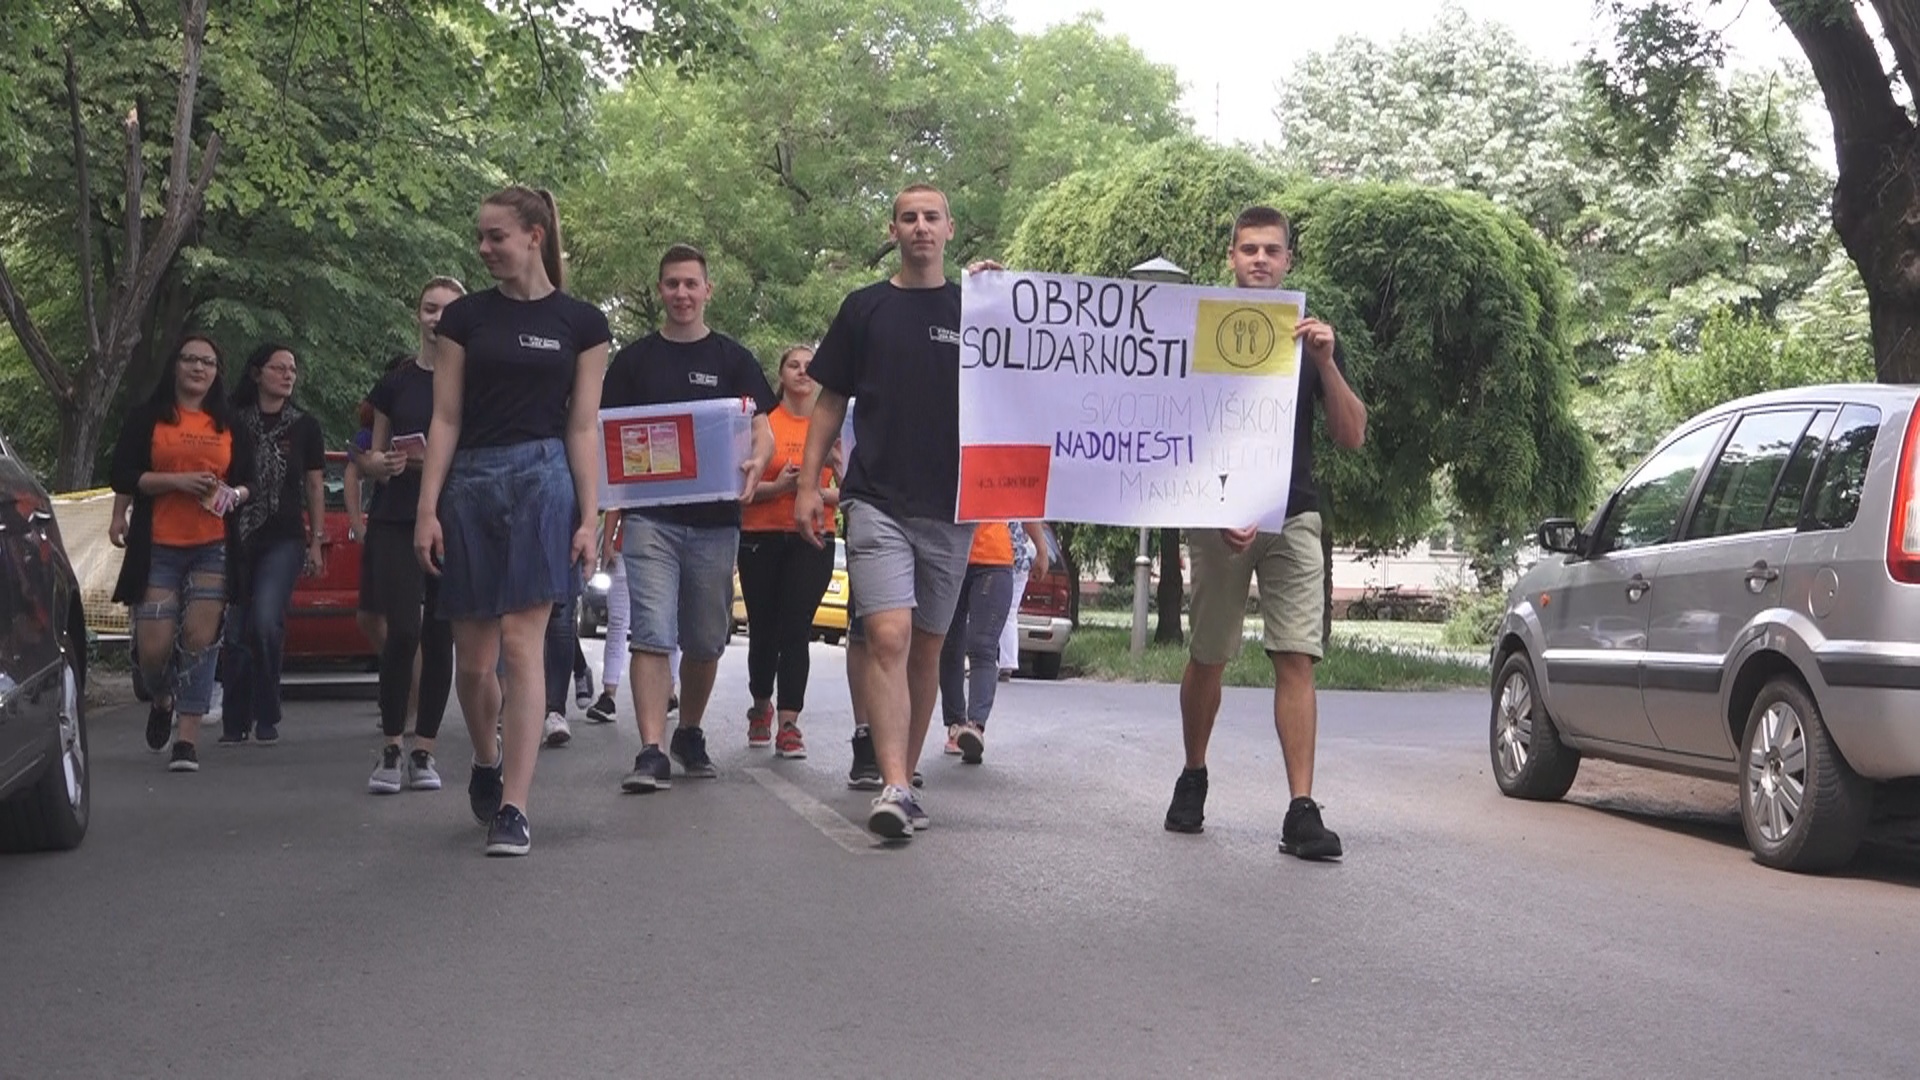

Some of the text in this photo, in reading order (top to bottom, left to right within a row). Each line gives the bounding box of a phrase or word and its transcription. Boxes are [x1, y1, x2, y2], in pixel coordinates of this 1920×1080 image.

[1012, 278, 1157, 334] OBROK
[961, 326, 1188, 378] SOLIDARNOSTI
[1080, 387, 1293, 434] SVOJIM VIŠKOM
[1055, 431, 1194, 467] NADOMESTI
